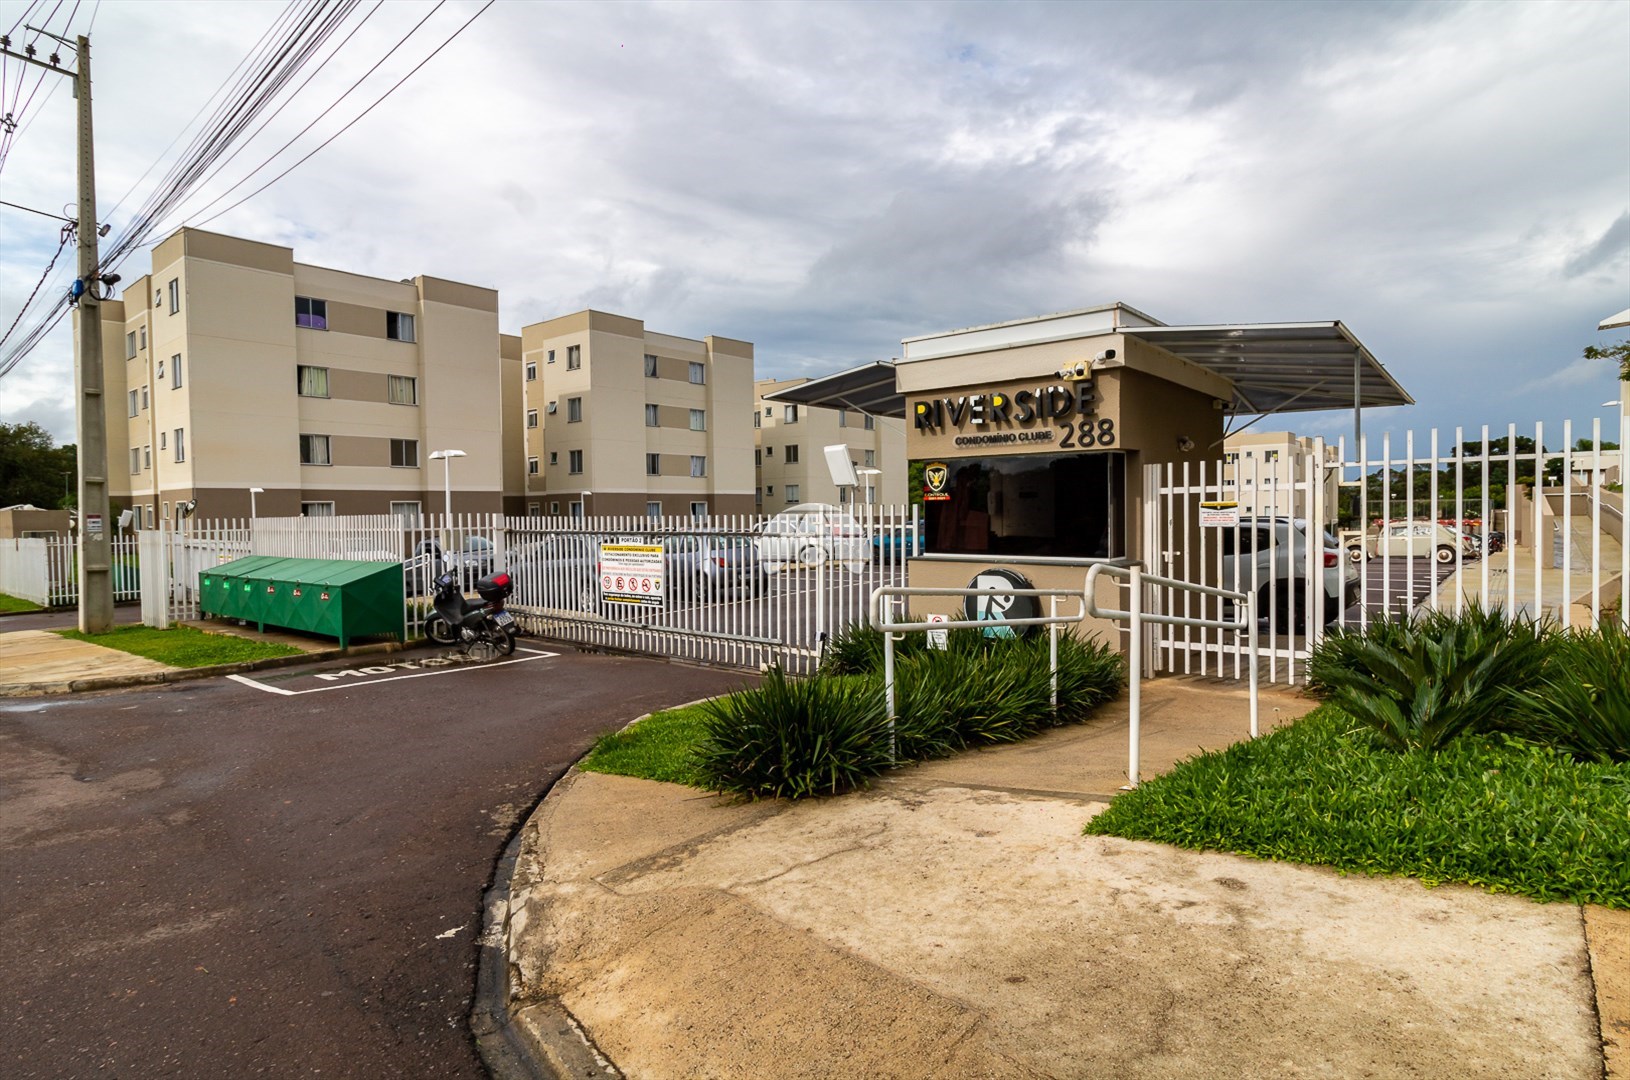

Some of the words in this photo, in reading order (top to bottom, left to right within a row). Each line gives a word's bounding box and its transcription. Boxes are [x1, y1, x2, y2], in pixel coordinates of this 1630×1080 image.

[914, 382, 1096, 429] RIVERSIDE
[955, 433, 1017, 445] CONDOMÍNIO
[1018, 430, 1053, 441] CLUBE
[1059, 418, 1115, 448] 288
